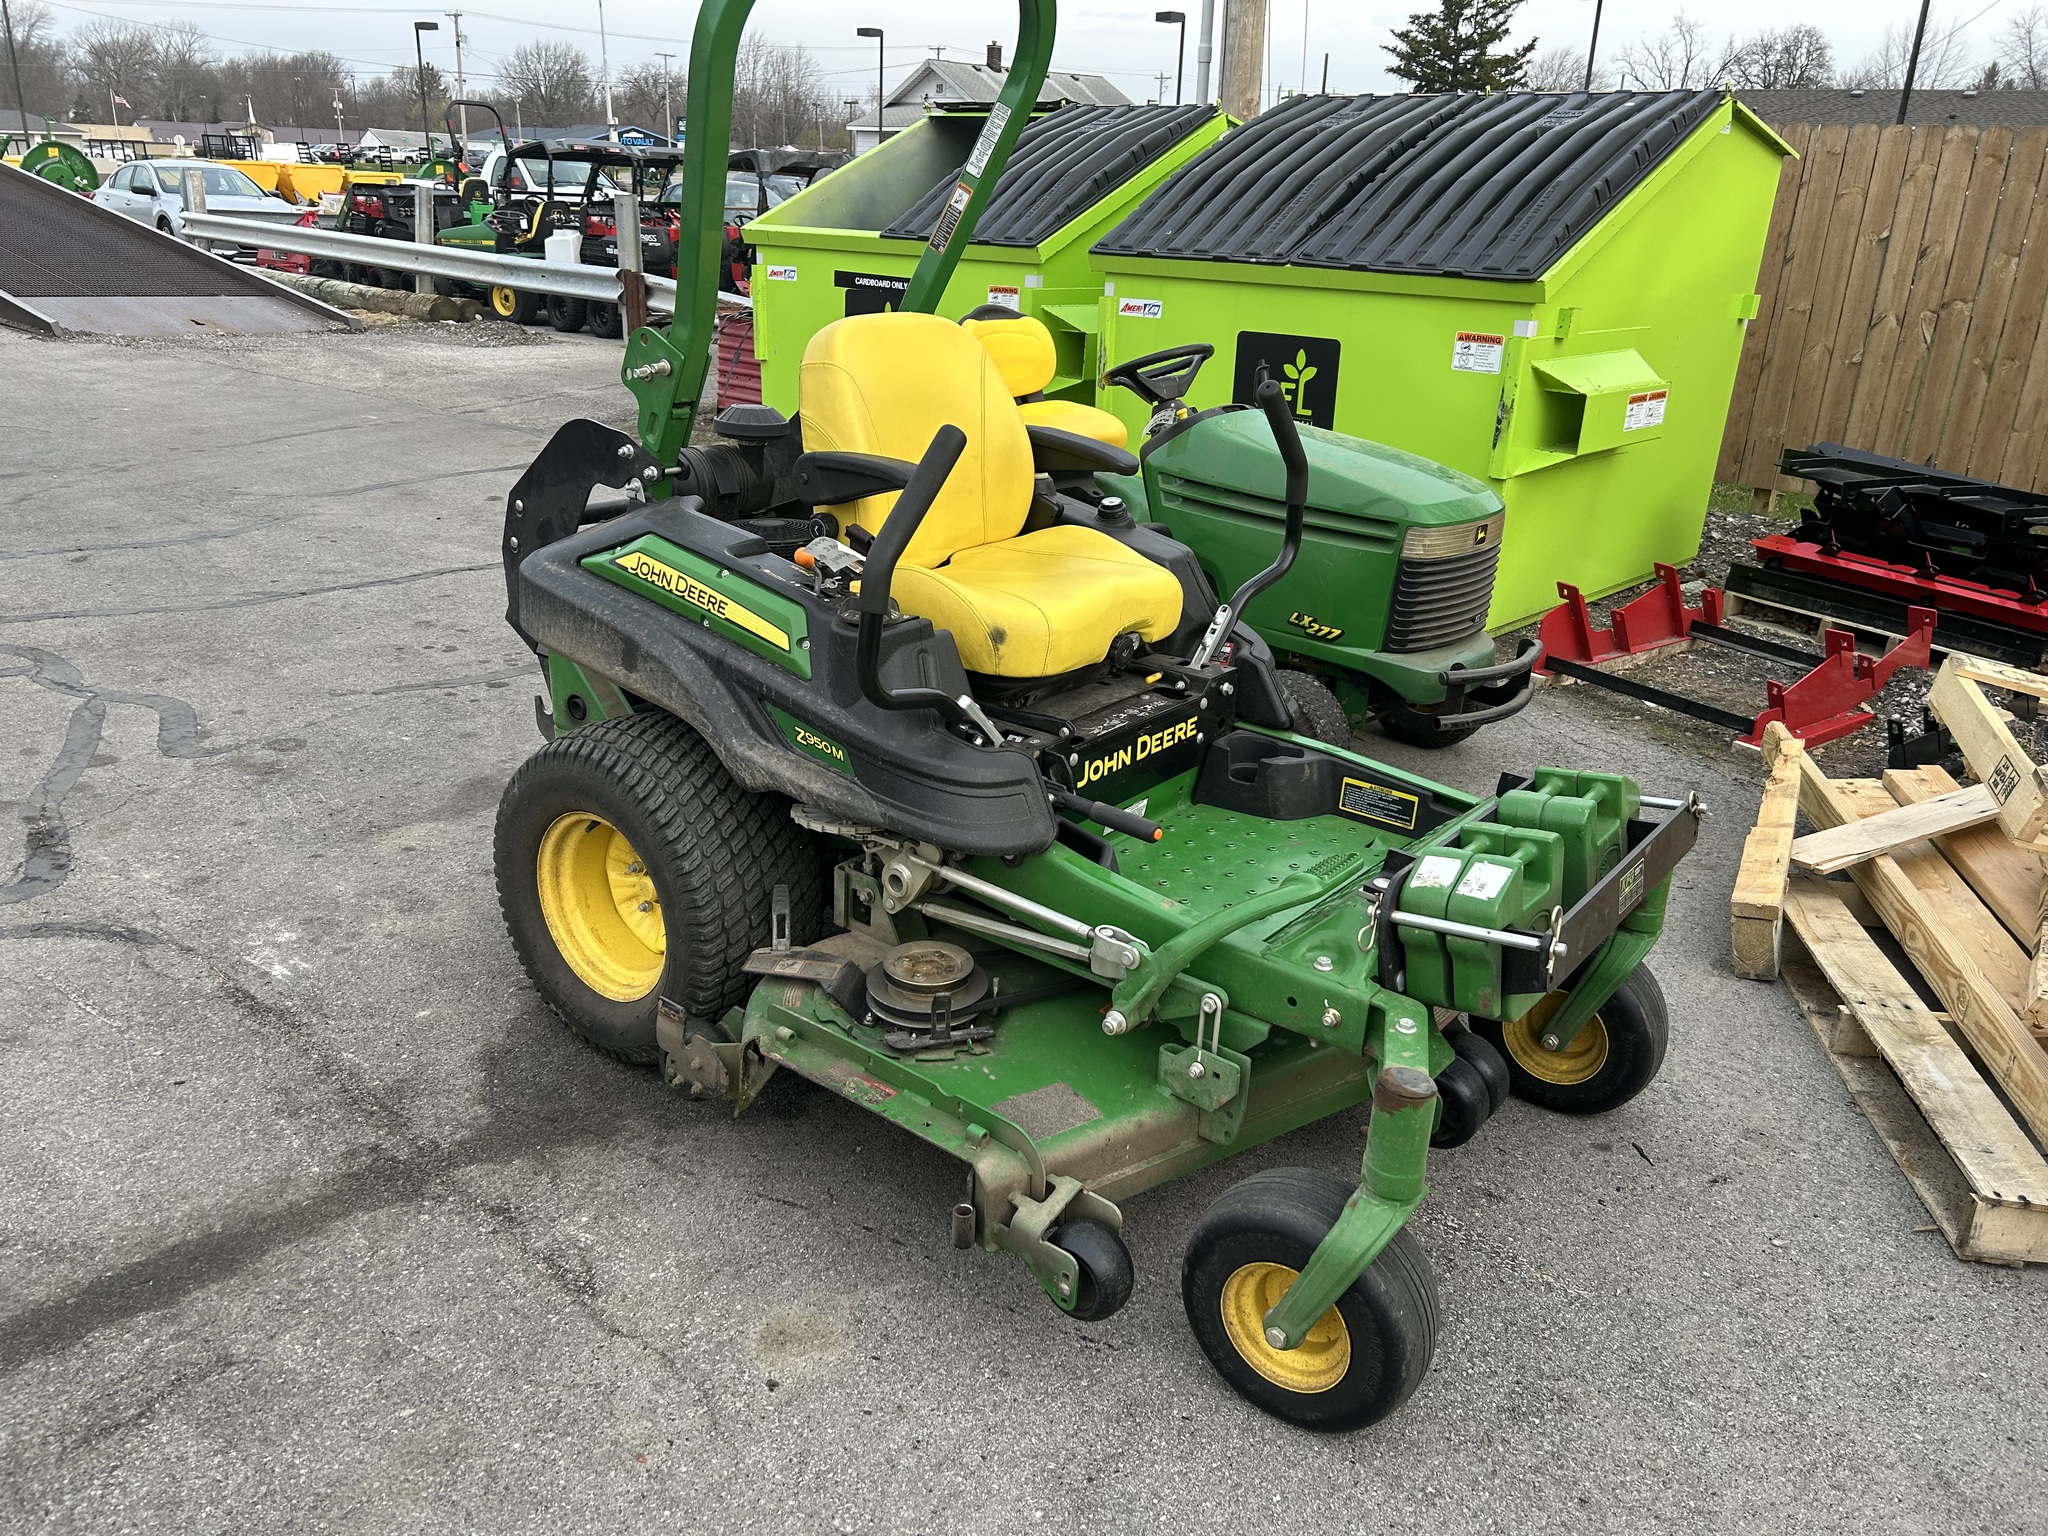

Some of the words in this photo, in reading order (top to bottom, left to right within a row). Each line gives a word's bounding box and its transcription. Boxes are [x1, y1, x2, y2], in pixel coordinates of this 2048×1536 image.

[632, 138, 655, 146] VAULT
[855, 277, 891, 289] CARDBOARD
[891, 281, 909, 290] ONLY
[1464, 333, 1502, 345] WARNING
[629, 555, 673, 588] JOHN
[674, 574, 729, 617] DEERE
[1076, 745, 1132, 789] JOHN
[1136, 715, 1199, 762] DEERE
